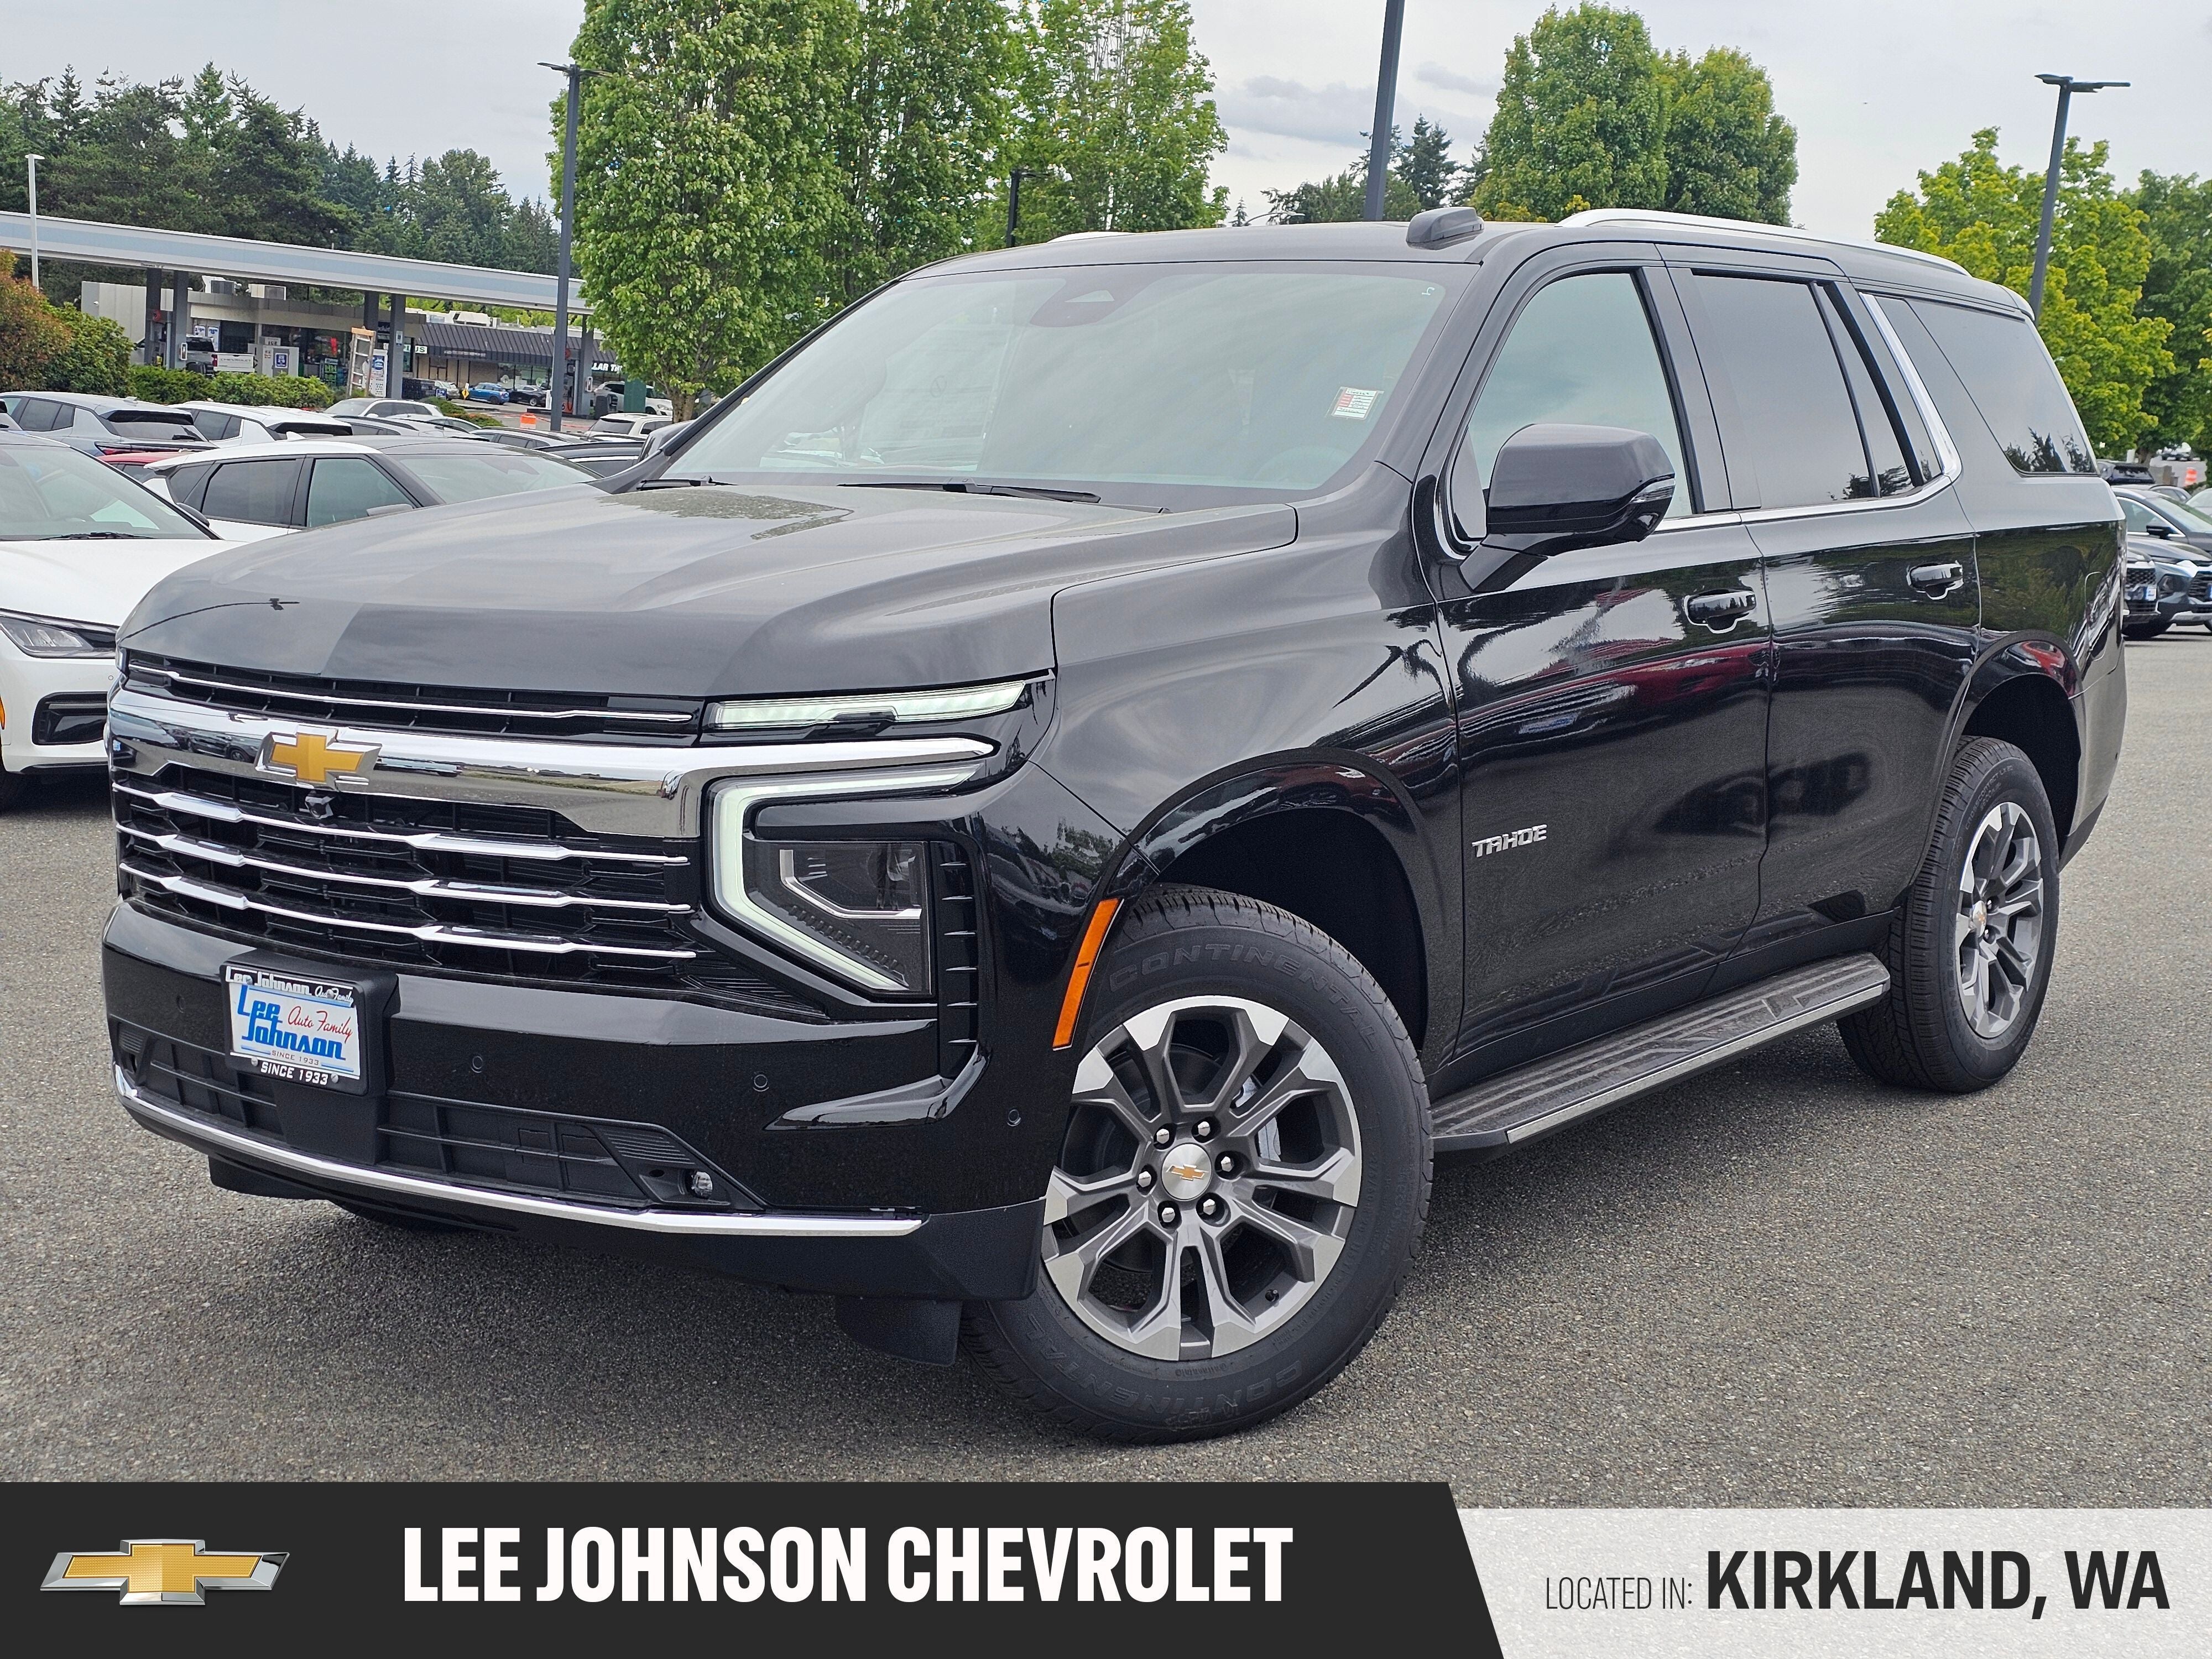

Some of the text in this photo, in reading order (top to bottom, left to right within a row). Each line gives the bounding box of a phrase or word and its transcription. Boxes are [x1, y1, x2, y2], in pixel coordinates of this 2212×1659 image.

[1472, 824, 1547, 858] TAHOE
[237, 984, 283, 1023] Lee
[1109, 943, 1382, 1052] CONTINENTAL
[242, 1016, 346, 1061] Johnson
[288, 1005, 353, 1044] Auto Family
[260, 1062, 328, 1086] SINCE 1933
[272, 1050, 319, 1066] SINCE 1933
